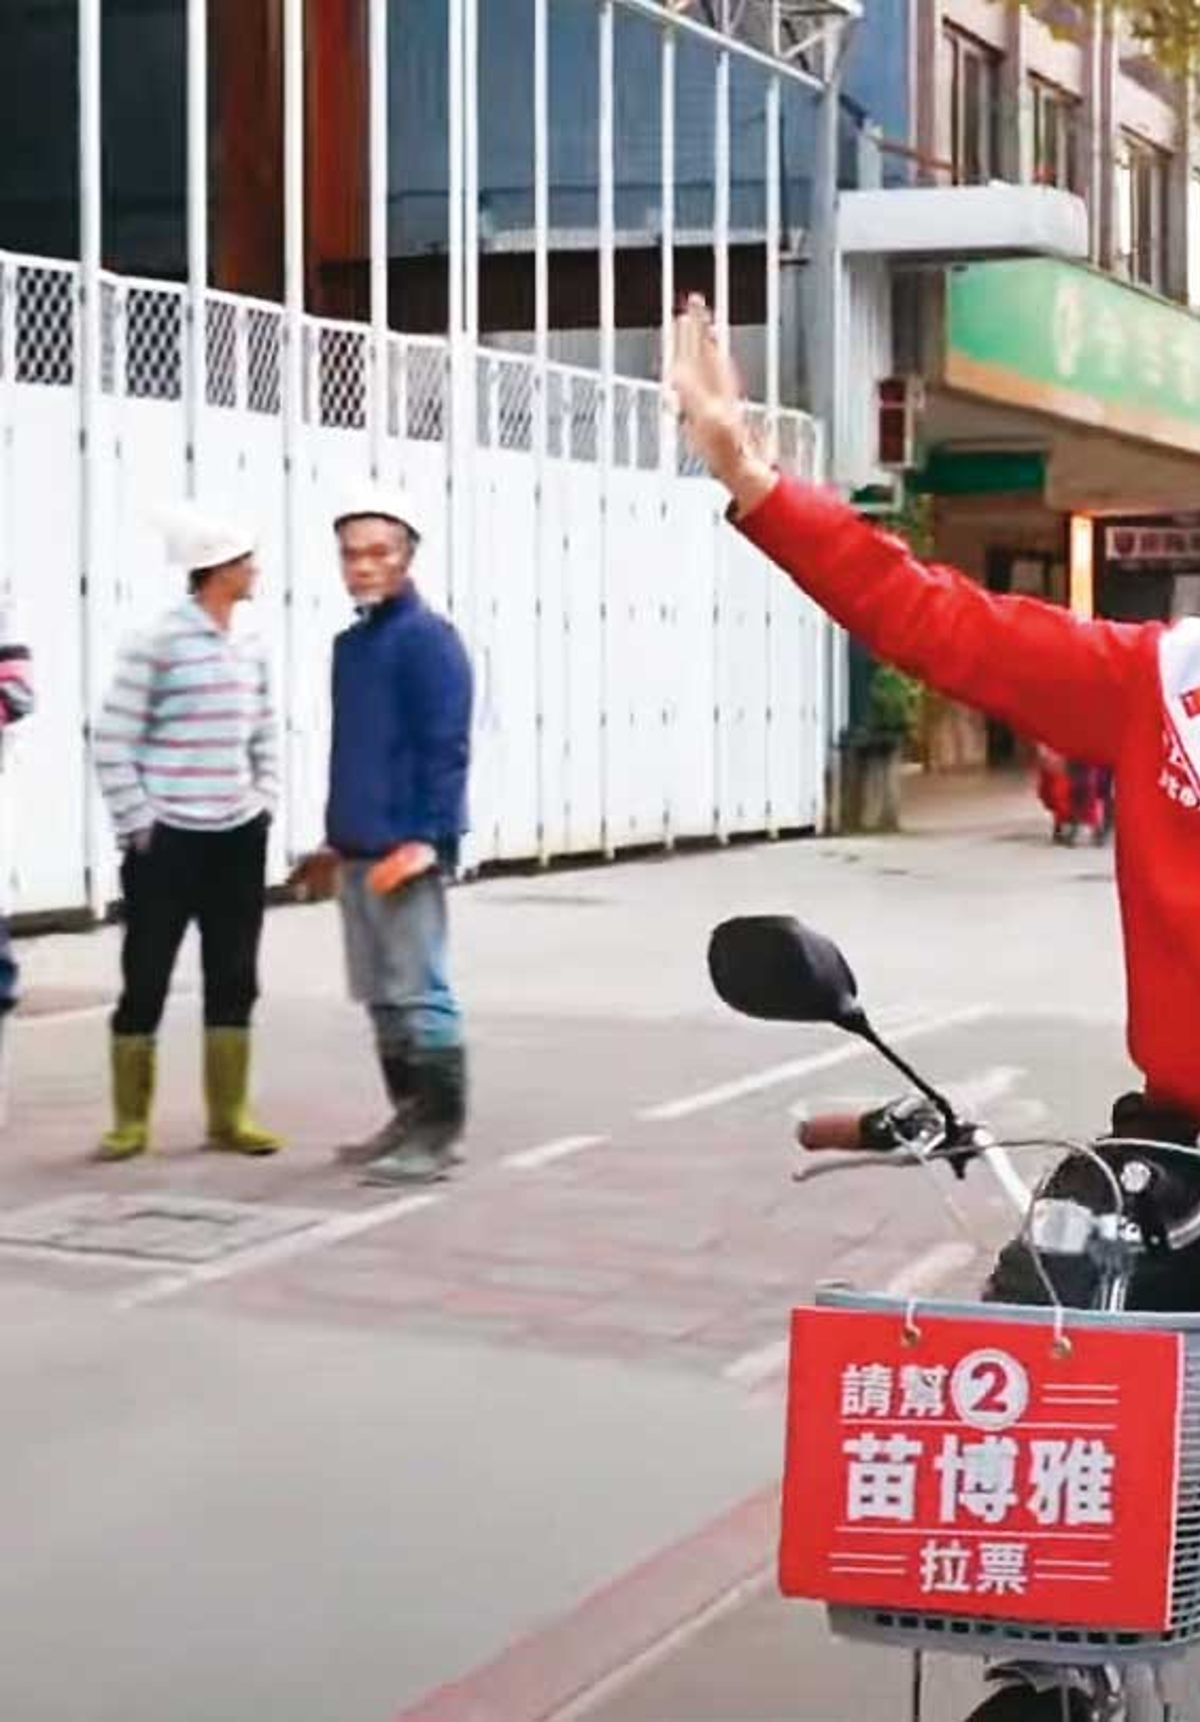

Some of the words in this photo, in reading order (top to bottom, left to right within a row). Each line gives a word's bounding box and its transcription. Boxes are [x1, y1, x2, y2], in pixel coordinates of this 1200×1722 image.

[841, 1433, 1116, 1525] 苗博雅
[919, 1541, 1029, 1596] 拉票
